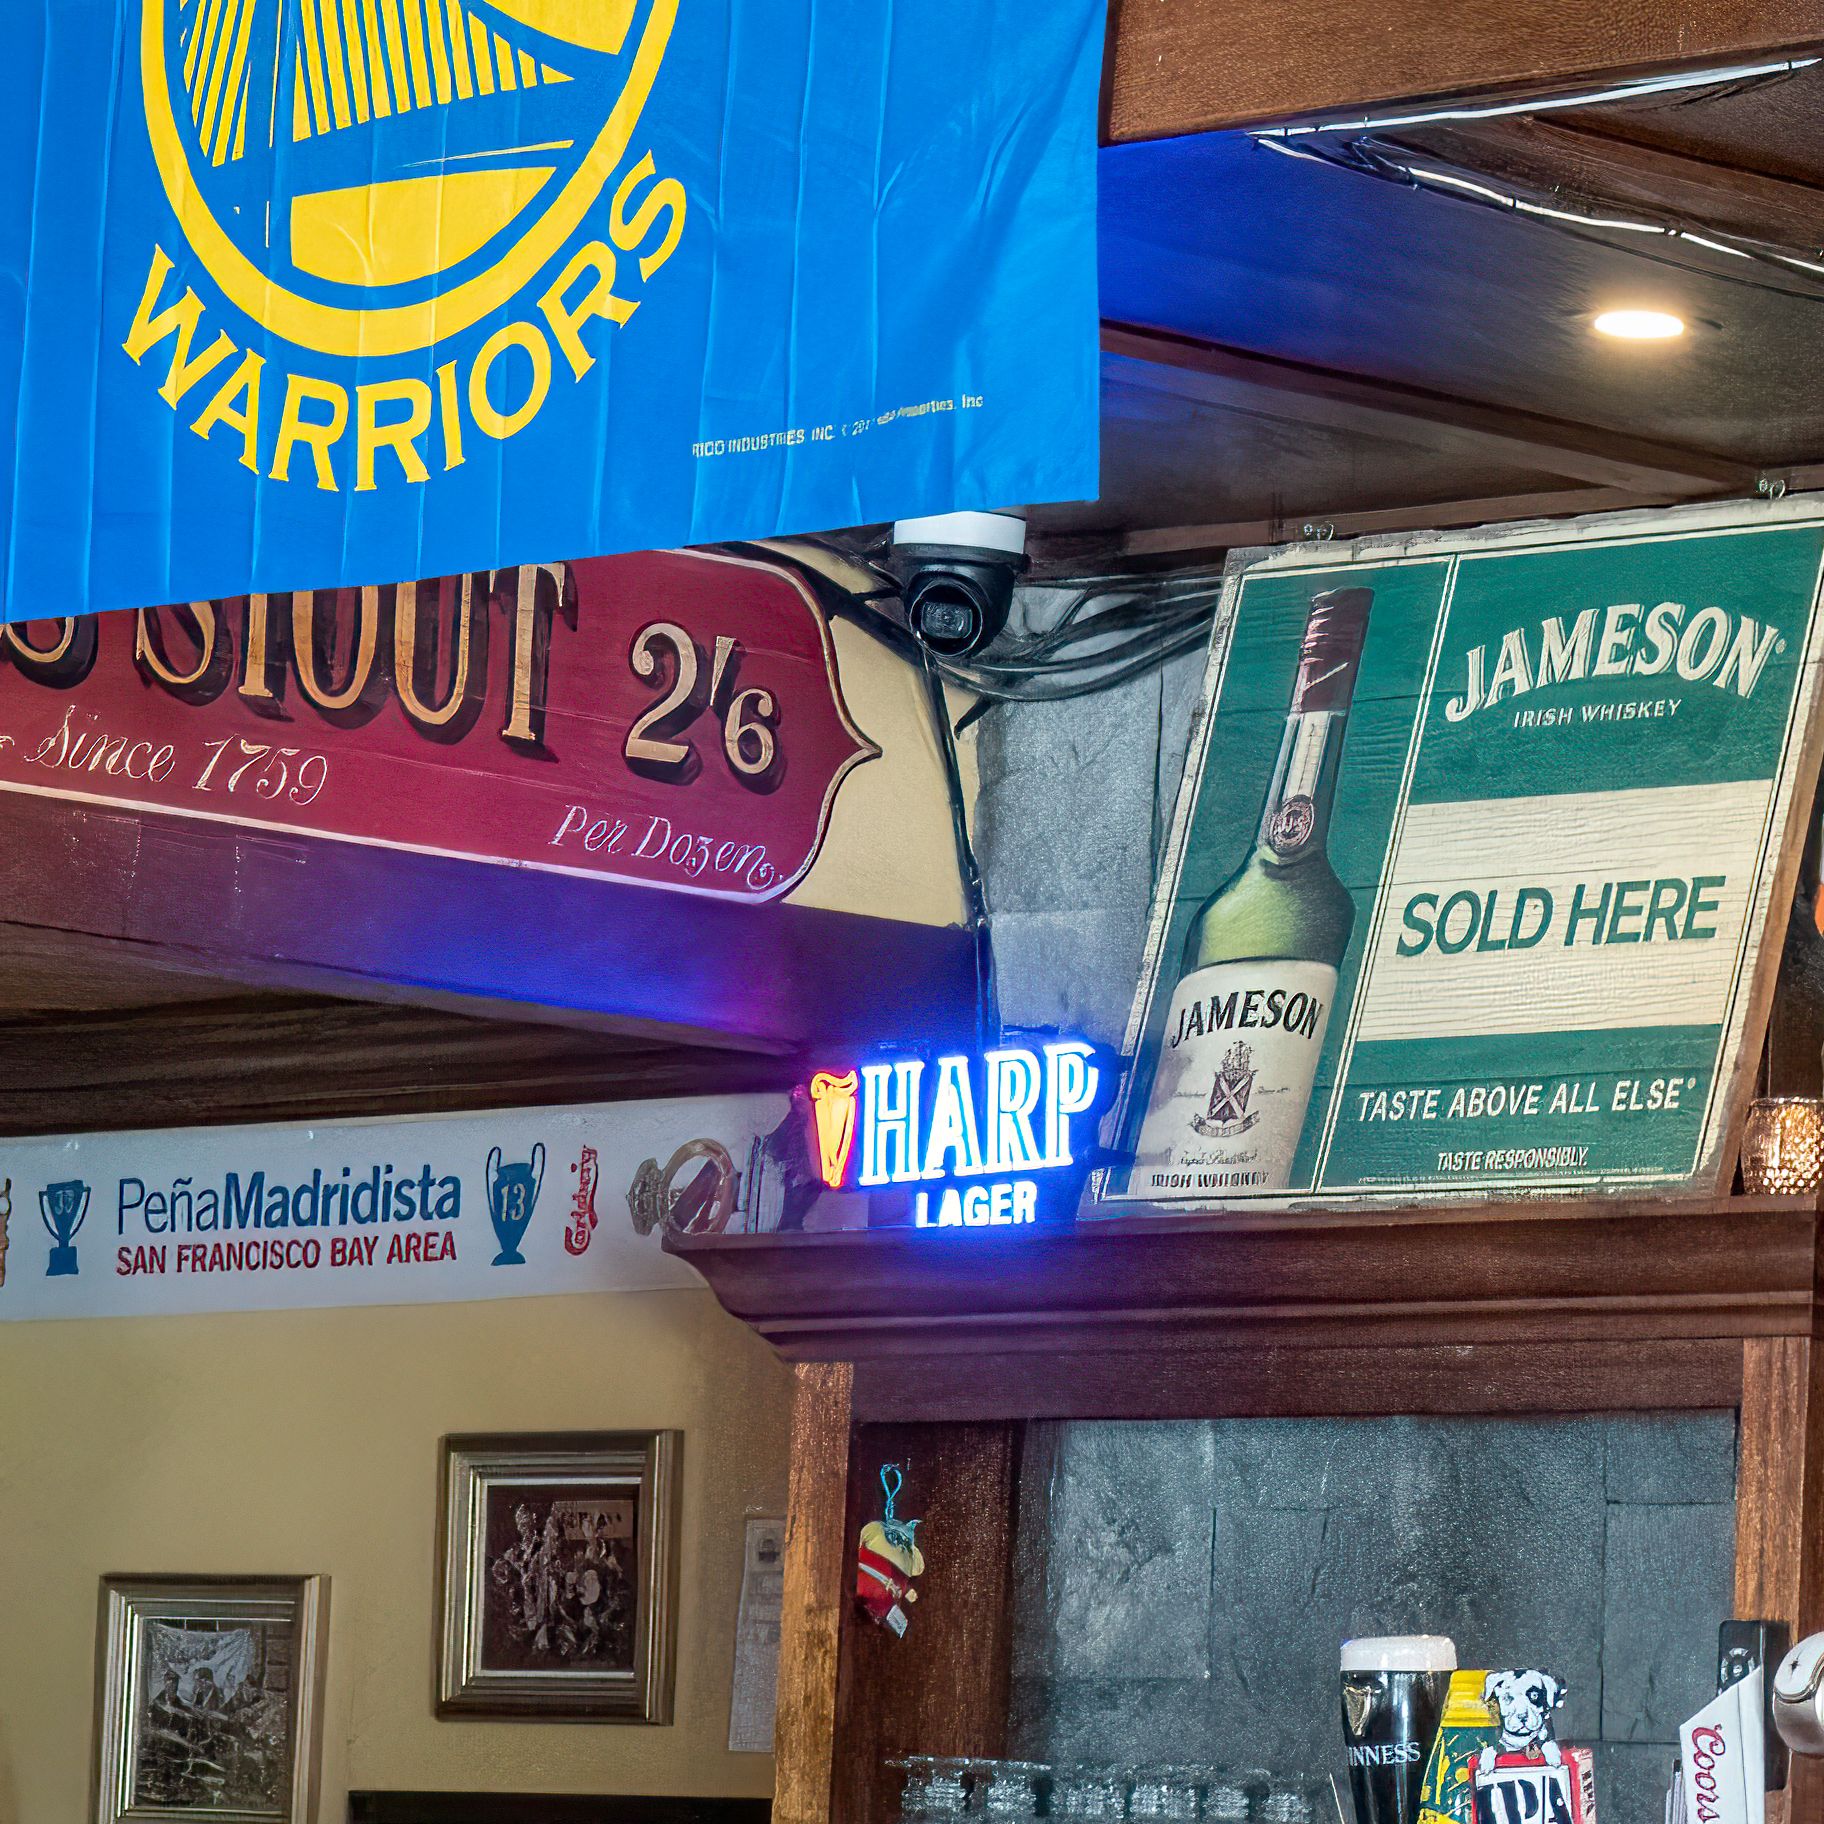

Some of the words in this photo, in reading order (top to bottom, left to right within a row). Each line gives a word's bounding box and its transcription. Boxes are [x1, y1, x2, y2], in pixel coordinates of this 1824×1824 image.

[122, 149, 688, 492] WARRIORS
[1445, 601, 1781, 723] JAMESON
[1513, 706, 1573, 728] IRISH
[1582, 698, 1683, 724] WHISKEY
[27, 704, 175, 784] Since
[191, 734, 329, 806] 1759
[548, 804, 625, 855] Per
[1396, 886, 1554, 958] SOLD
[1563, 875, 1727, 947] HERE
[1171, 988, 1324, 1049] JAMESON
[858, 1042, 1100, 1187] HARP
[1358, 1089, 1442, 1122] TASTE
[1447, 1084, 1543, 1119] ABOVE
[1549, 1082, 1601, 1115] ALL
[1611, 1077, 1685, 1112] ELSE
[1437, 1151, 1484, 1172] TASTE
[500, 1182, 527, 1223] 13
[915, 1180, 1039, 1229] LAGER
[115, 1245, 167, 1277] SAN
[175, 1238, 322, 1273] FRANCISCO
[329, 1235, 379, 1267] BAY
[386, 1231, 459, 1265] AREA
[1691, 1723, 1727, 1824] Coors
